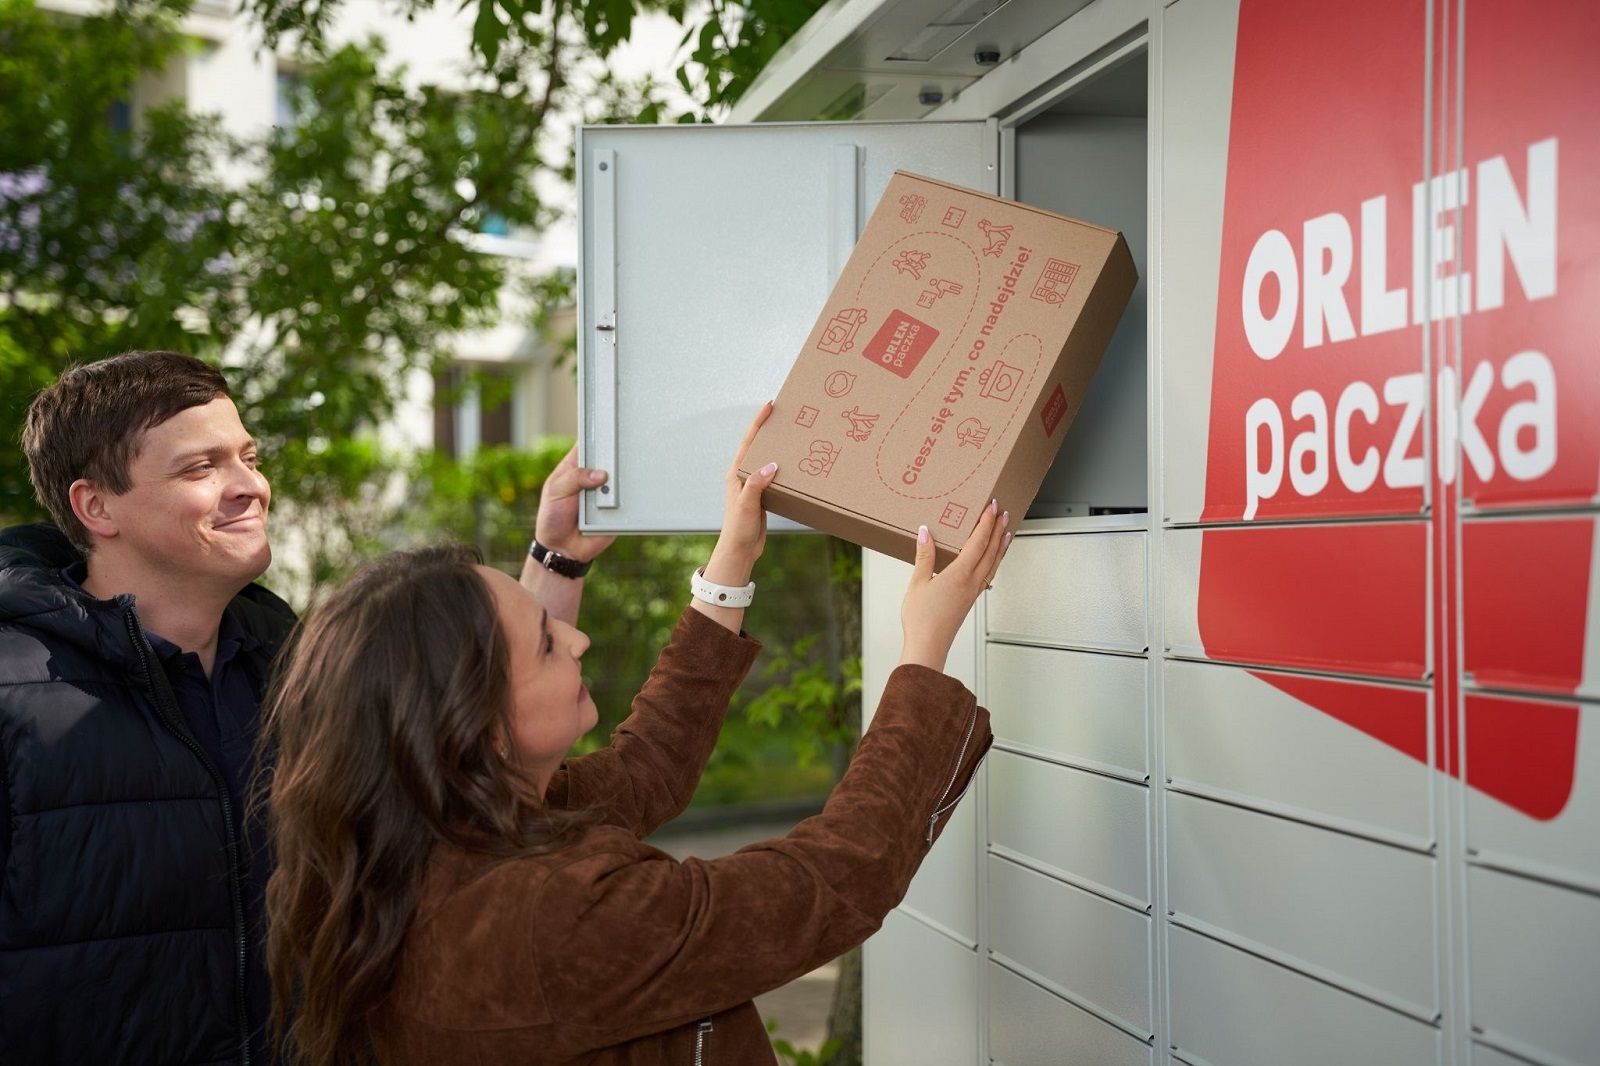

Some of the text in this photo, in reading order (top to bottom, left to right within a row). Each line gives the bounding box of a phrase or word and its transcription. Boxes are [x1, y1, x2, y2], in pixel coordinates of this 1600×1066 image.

[1242, 137, 1558, 360] ORLEN
[882, 321, 910, 363] ORLEN
[893, 325, 920, 367] paczka
[902, 246, 1032, 485] Ciesz się tym, co nadejdzie!
[1242, 350, 1558, 520] paczka
